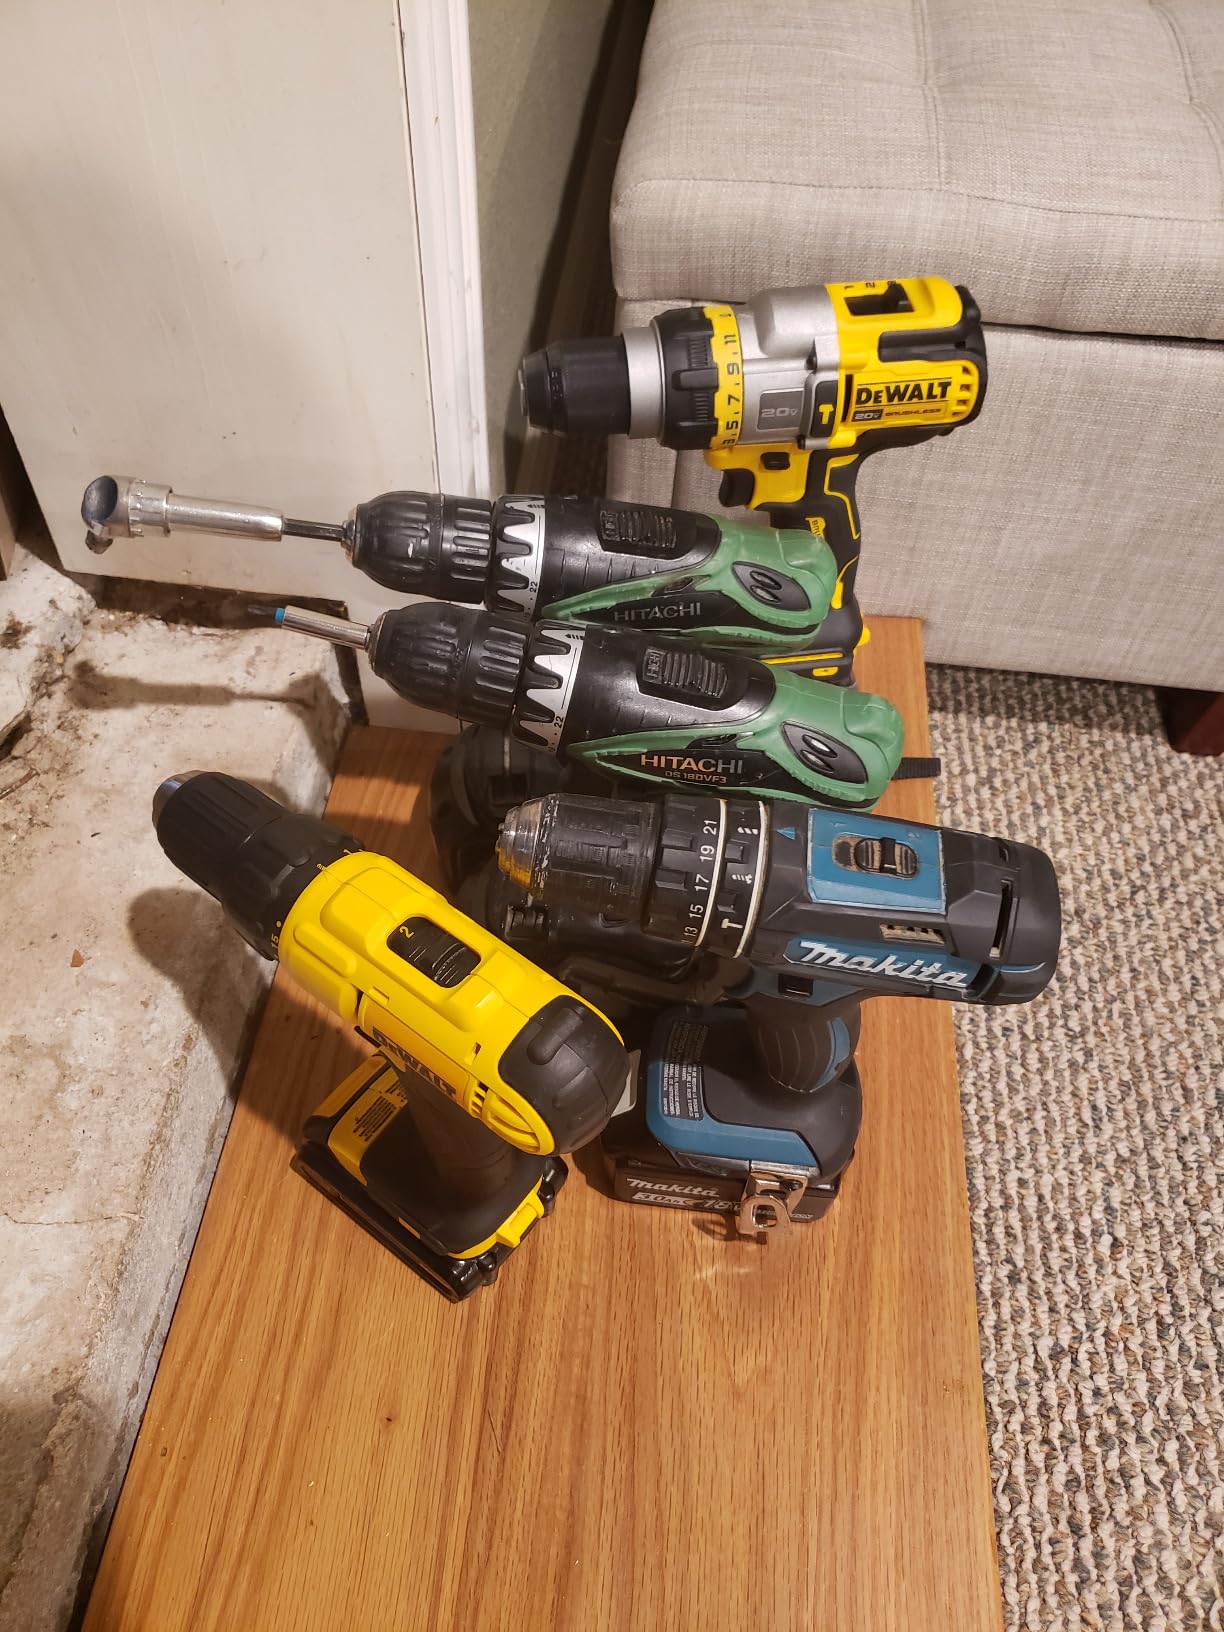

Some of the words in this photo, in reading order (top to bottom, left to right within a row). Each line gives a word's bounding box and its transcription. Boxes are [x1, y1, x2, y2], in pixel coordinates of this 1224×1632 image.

[723, 334, 737, 346] 11
[727, 362, 740, 375] 9
[728, 394, 741, 406] 7
[854, 381, 952, 405] DEWALT
[726, 420, 739, 430] 5
[529, 581, 538, 593] 22
[613, 602, 702, 622] HITACHI
[553, 715, 564, 729] 22
[640, 754, 744, 774] HITACHI
[703, 819, 718, 836] 21
[699, 844, 715, 862] 19
[694, 873, 710, 892] 17
[688, 903, 704, 919] 15
[400, 925, 415, 939] 2
